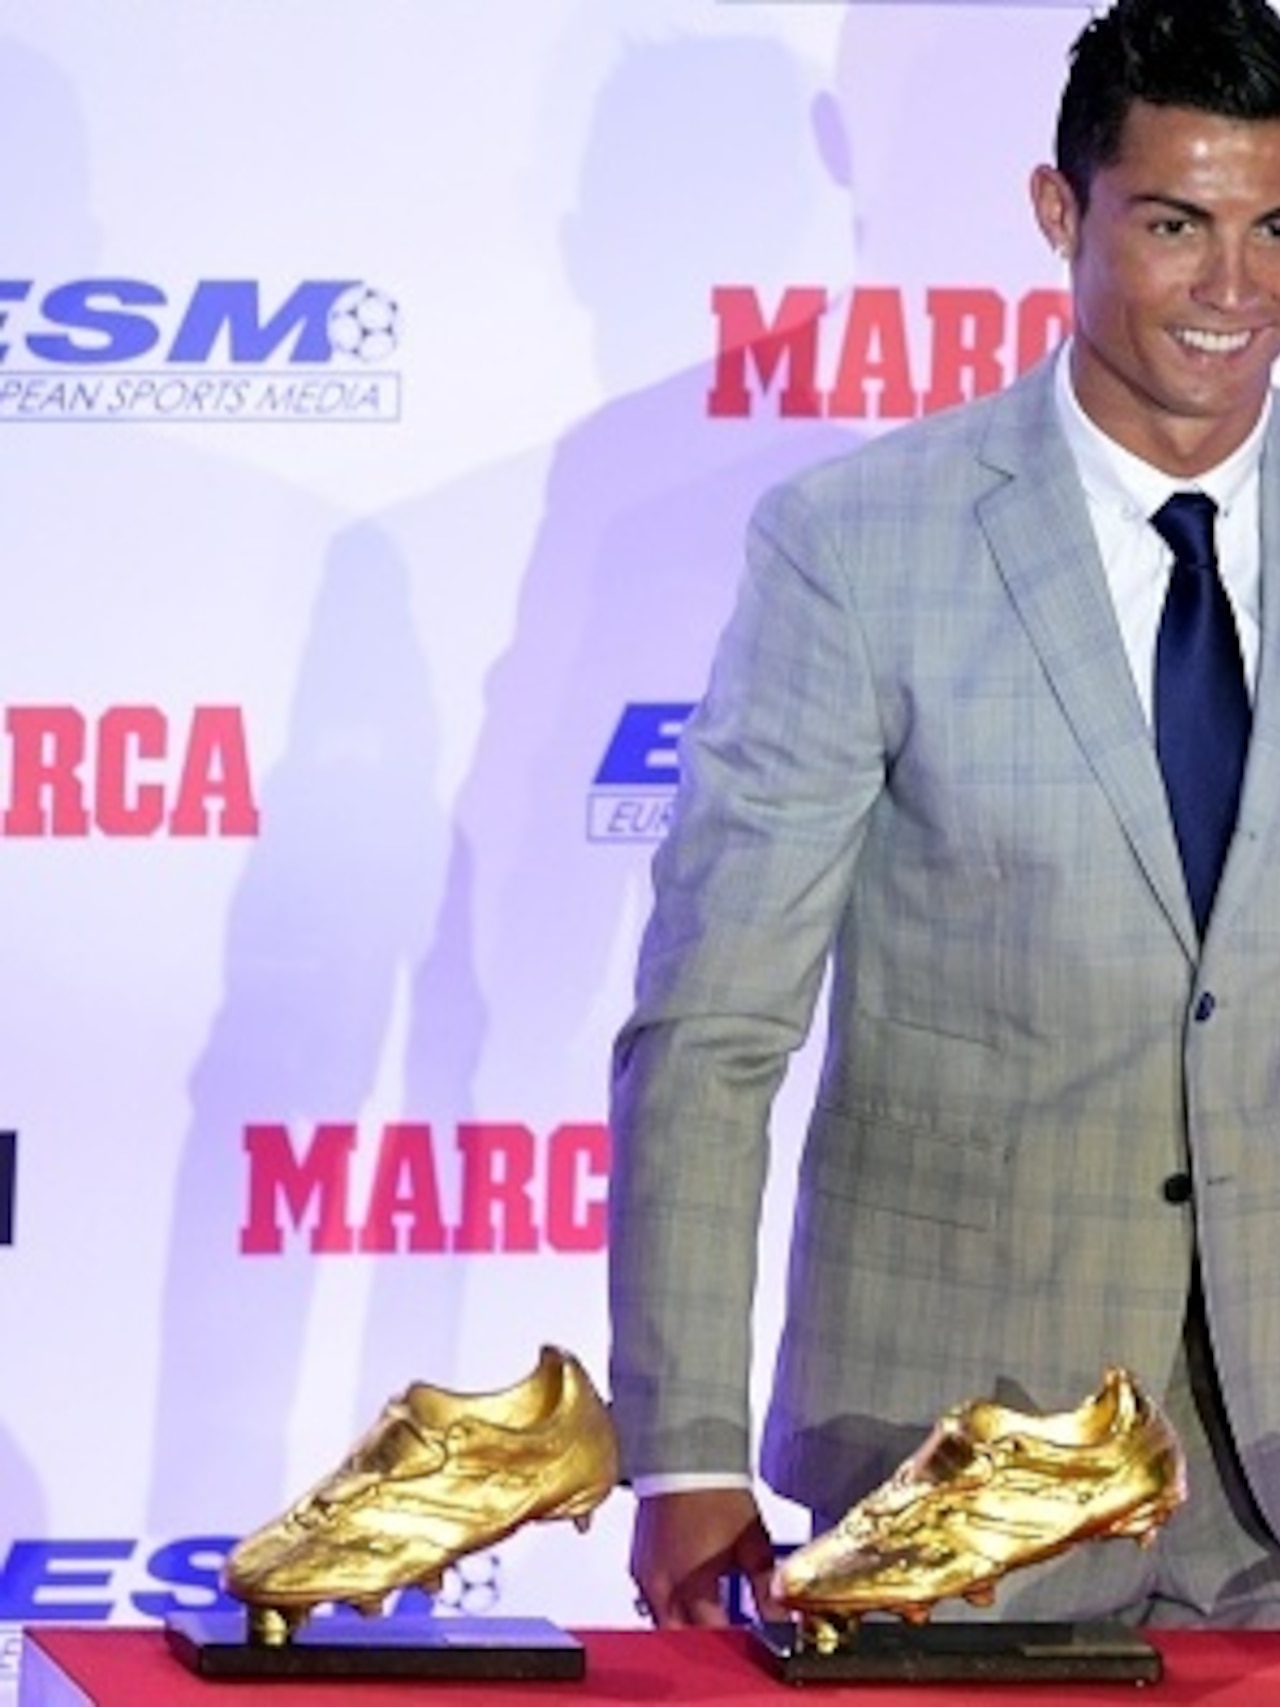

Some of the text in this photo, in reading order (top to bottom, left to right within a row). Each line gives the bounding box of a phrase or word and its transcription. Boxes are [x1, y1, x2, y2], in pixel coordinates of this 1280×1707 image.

[0, 279, 363, 364] SM
[107, 379, 251, 414] SPORTS
[253, 380, 382, 415] MEDIA
[4, 705, 260, 837] RCA
[239, 1122, 611, 1255] MARC
